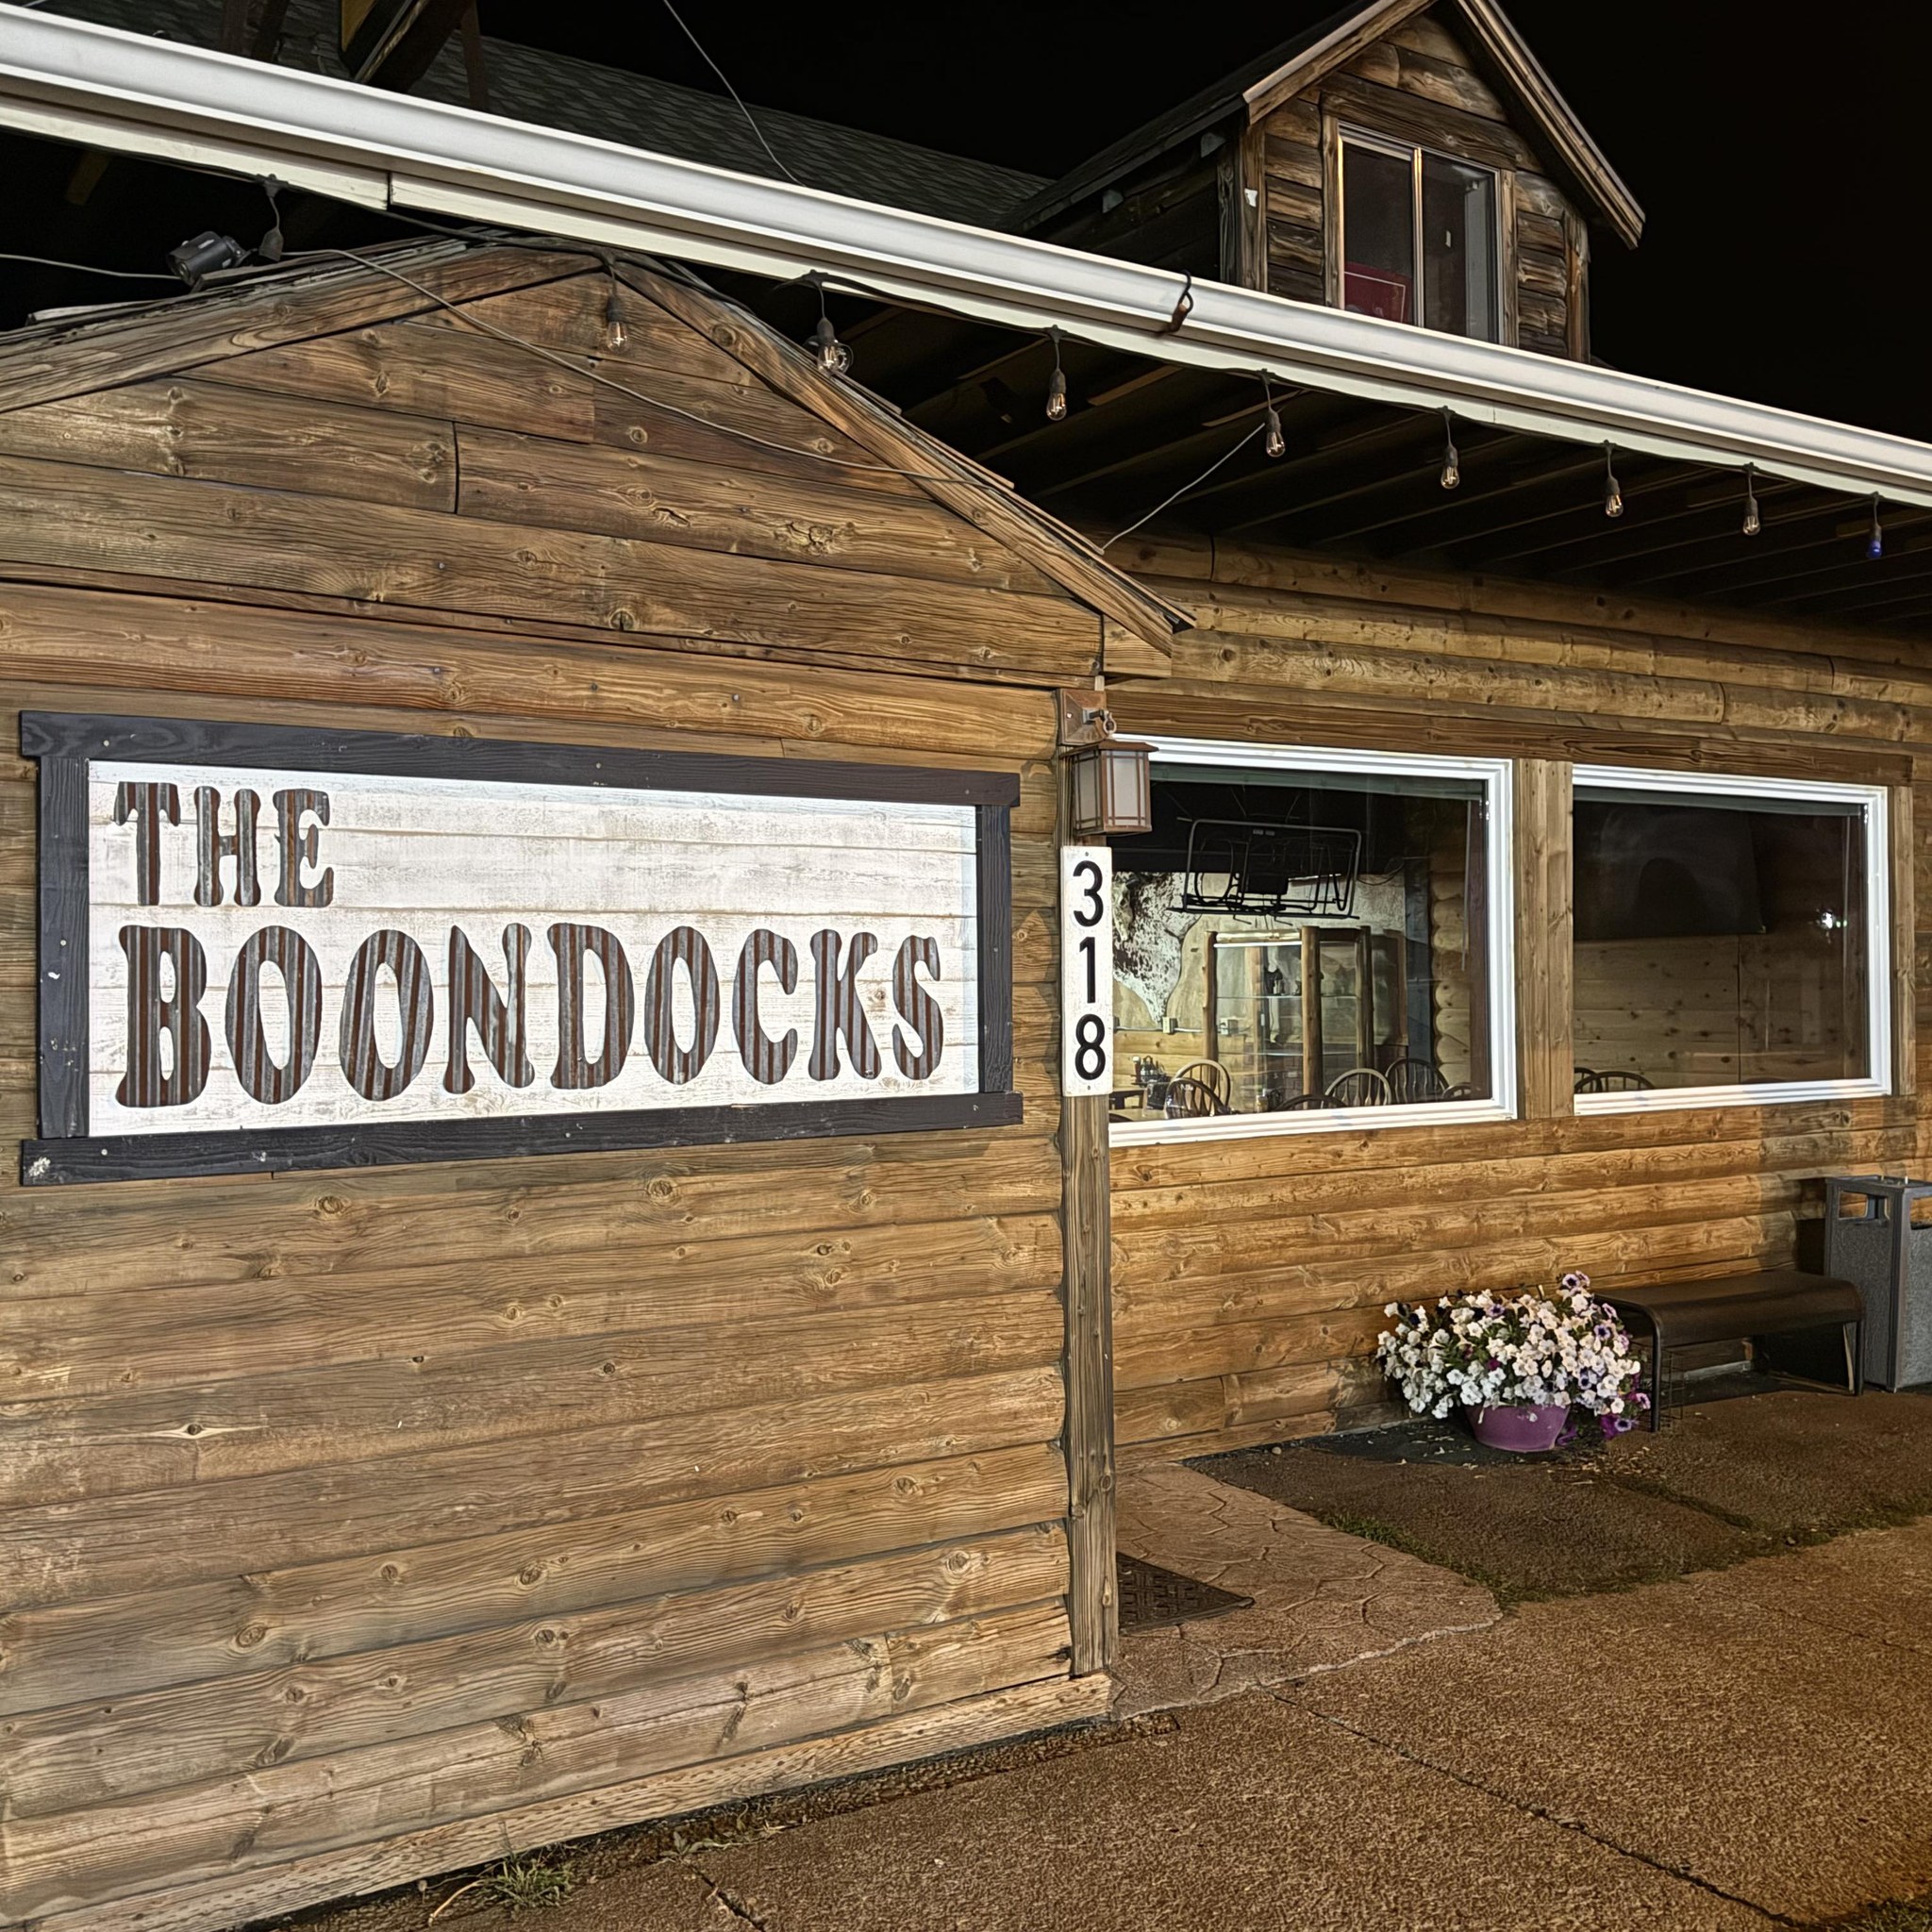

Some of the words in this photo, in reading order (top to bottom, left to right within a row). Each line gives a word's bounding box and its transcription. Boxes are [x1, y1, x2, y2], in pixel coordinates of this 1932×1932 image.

[113, 781, 334, 908] THE
[115, 923, 943, 1108] BOONDOCKS
[1072, 859, 1107, 1081] 318
